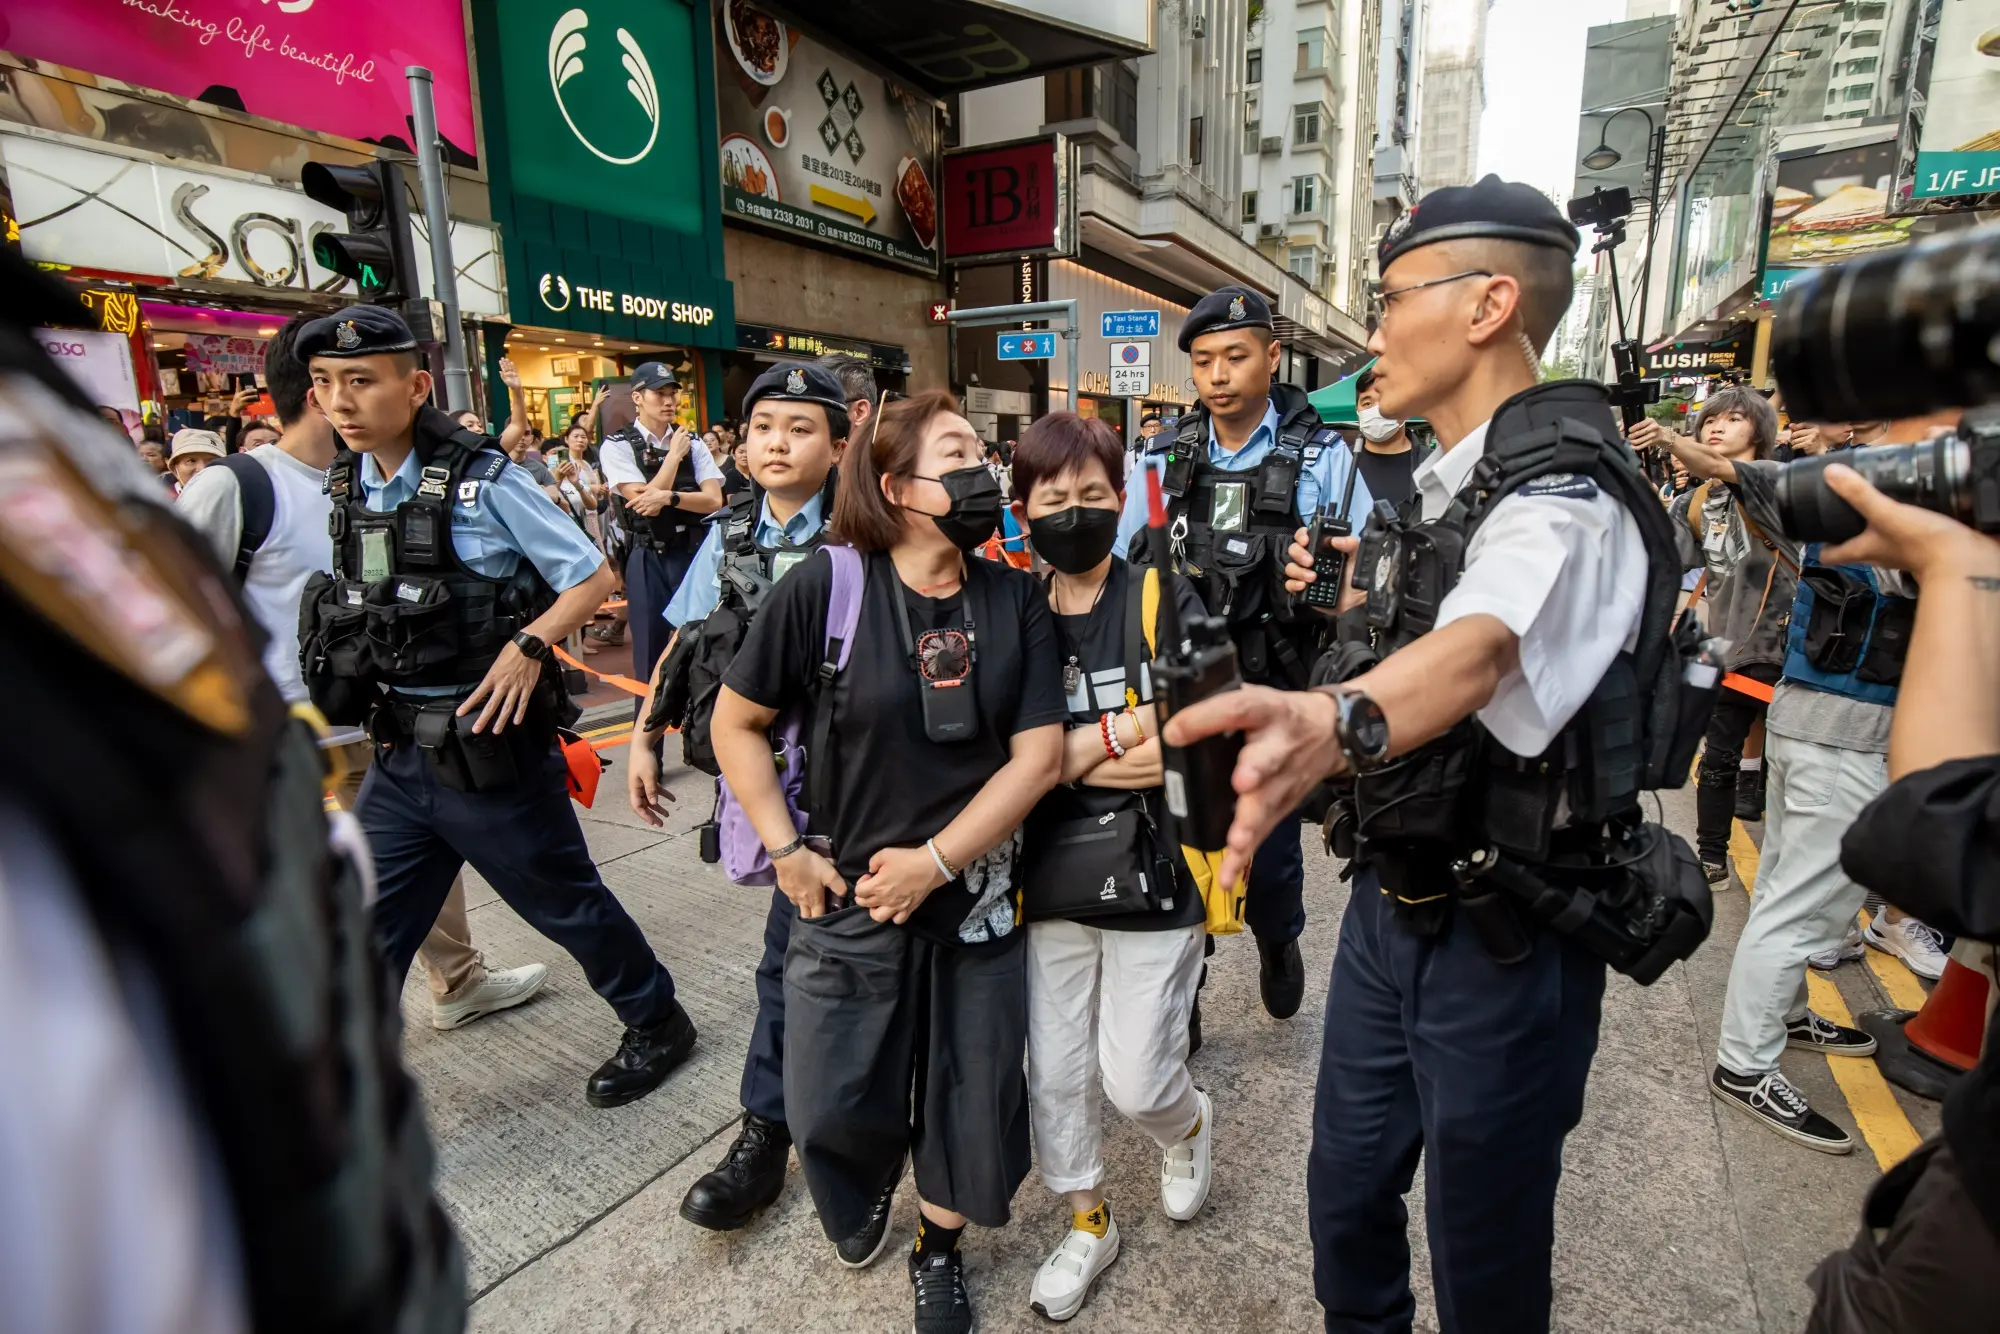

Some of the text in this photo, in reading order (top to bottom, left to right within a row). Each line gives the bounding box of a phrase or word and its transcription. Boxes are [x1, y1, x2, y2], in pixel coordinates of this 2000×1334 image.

[122, 0, 375, 86] making life beautiful
[1926, 169, 1968, 192] 1/F
[774, 207, 794, 225] 2338
[795, 213, 814, 231] 2031
[849, 233, 865, 247] 5233
[866, 238, 883, 251] 6775
[576, 286, 714, 326] THE BODY SHOP
[1113, 314, 1148, 323] Taxi Stand
[1115, 324, 1144, 334] 的士站
[1650, 352, 1708, 369] LUSH
[1115, 370, 1145, 379] 24 hrs
[1118, 381, 1141, 393] 全日
[485, 457, 504, 477] 29232
[932, 1257, 946, 1267] NIKE
